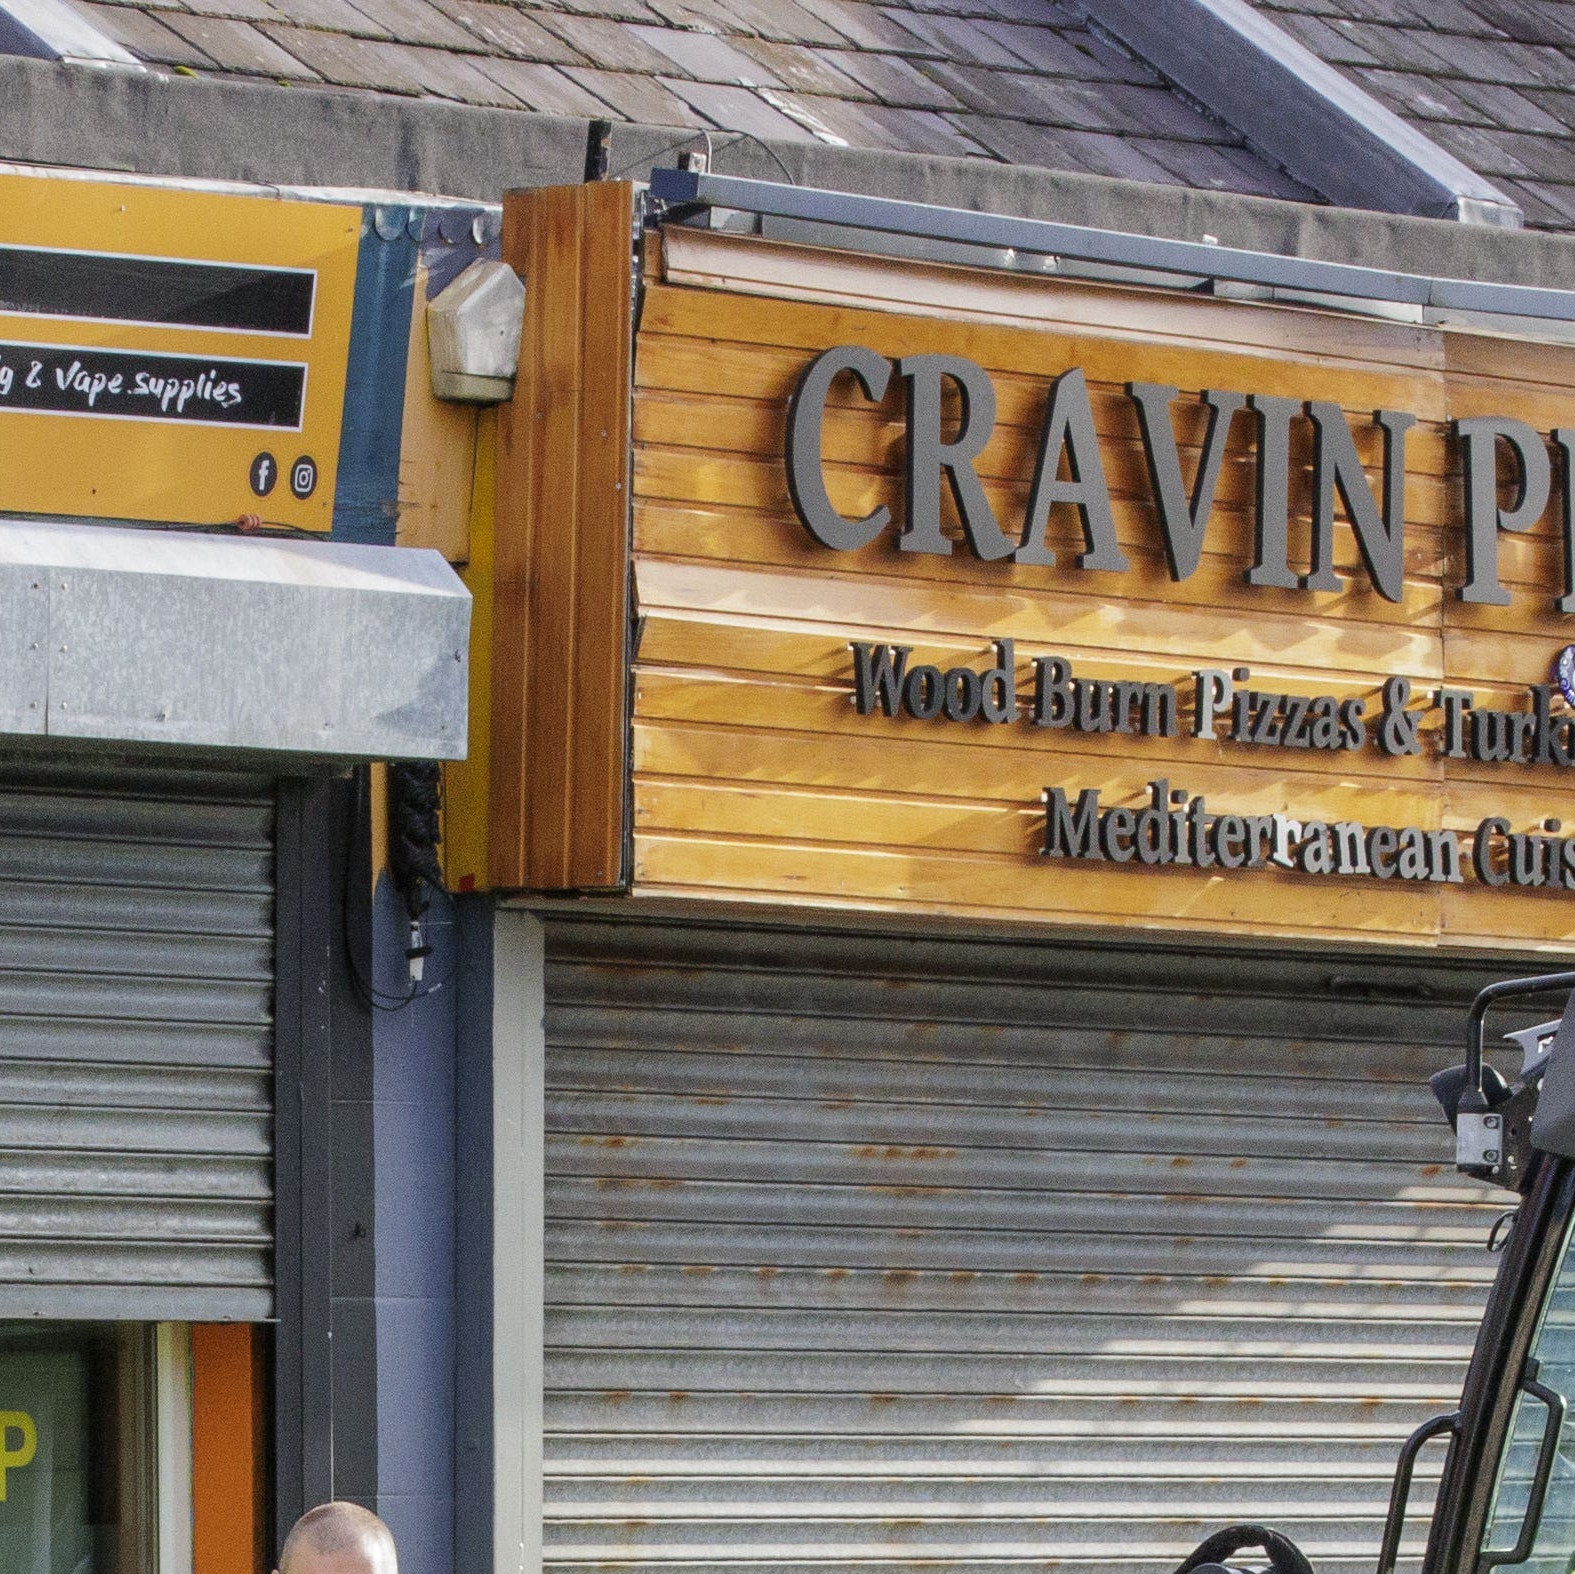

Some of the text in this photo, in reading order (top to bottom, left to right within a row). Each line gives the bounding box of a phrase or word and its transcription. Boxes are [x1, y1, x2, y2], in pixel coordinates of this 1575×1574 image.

[55, 360, 124, 407] Vape
[784, 345, 1415, 602] CRAVIN
[849, 638, 1020, 726] Wood
[1031, 656, 1177, 738] Burn
[1190, 666, 1367, 754] Pizzas
[1376, 676, 1426, 757] &
[1040, 778, 1463, 884] Mediterranean
